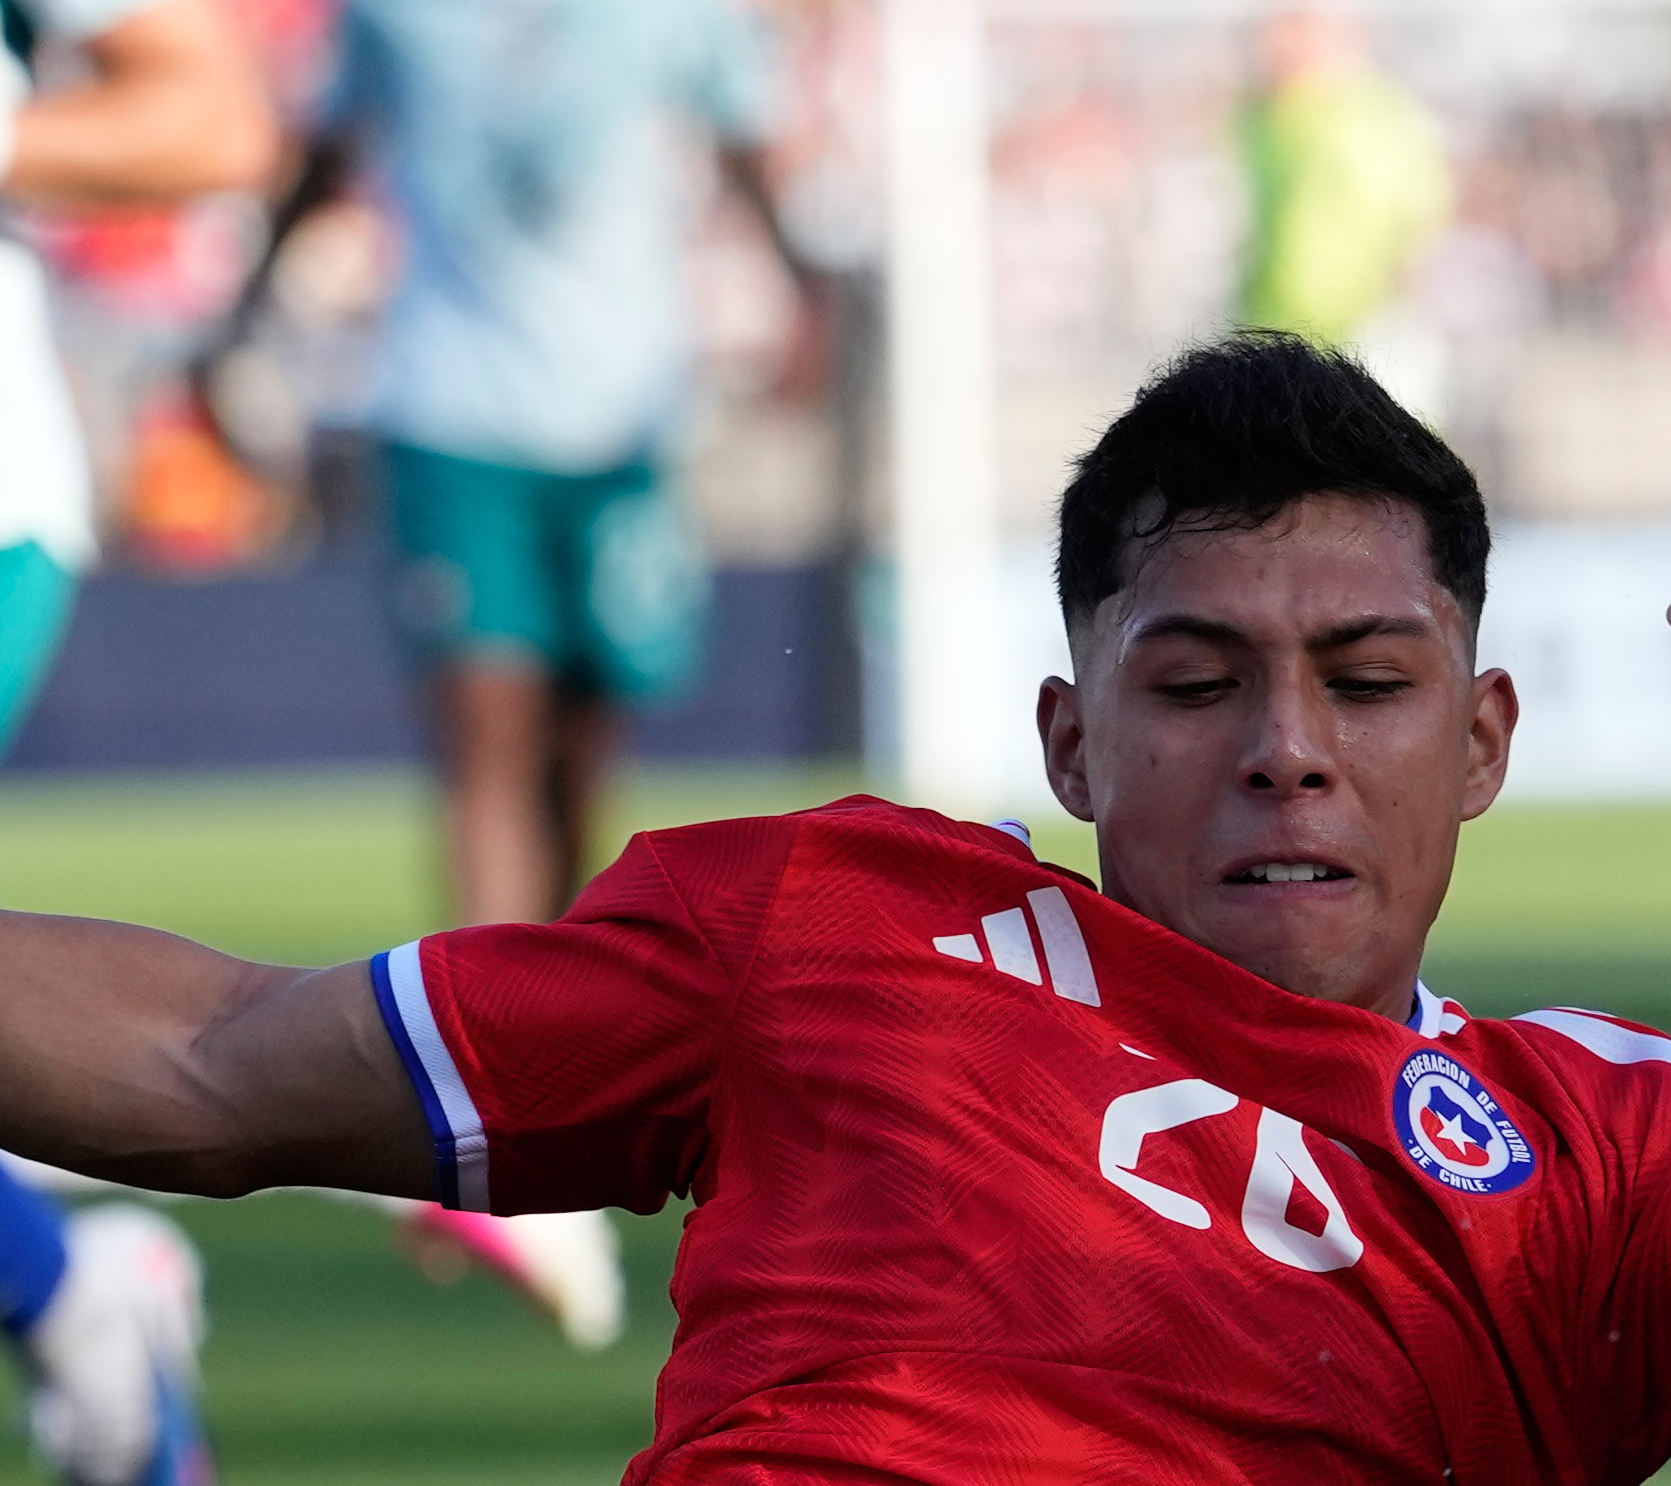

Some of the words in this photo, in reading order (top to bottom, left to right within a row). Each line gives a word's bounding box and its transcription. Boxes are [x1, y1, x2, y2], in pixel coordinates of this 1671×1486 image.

[1401, 1053, 1471, 1090] FEDERACION
[1475, 1090, 1498, 1115] DE
[1495, 1119, 1532, 1164] FUTBOL
[1408, 1145, 1433, 1170] DE
[1438, 1167, 1489, 1193] CHILE
